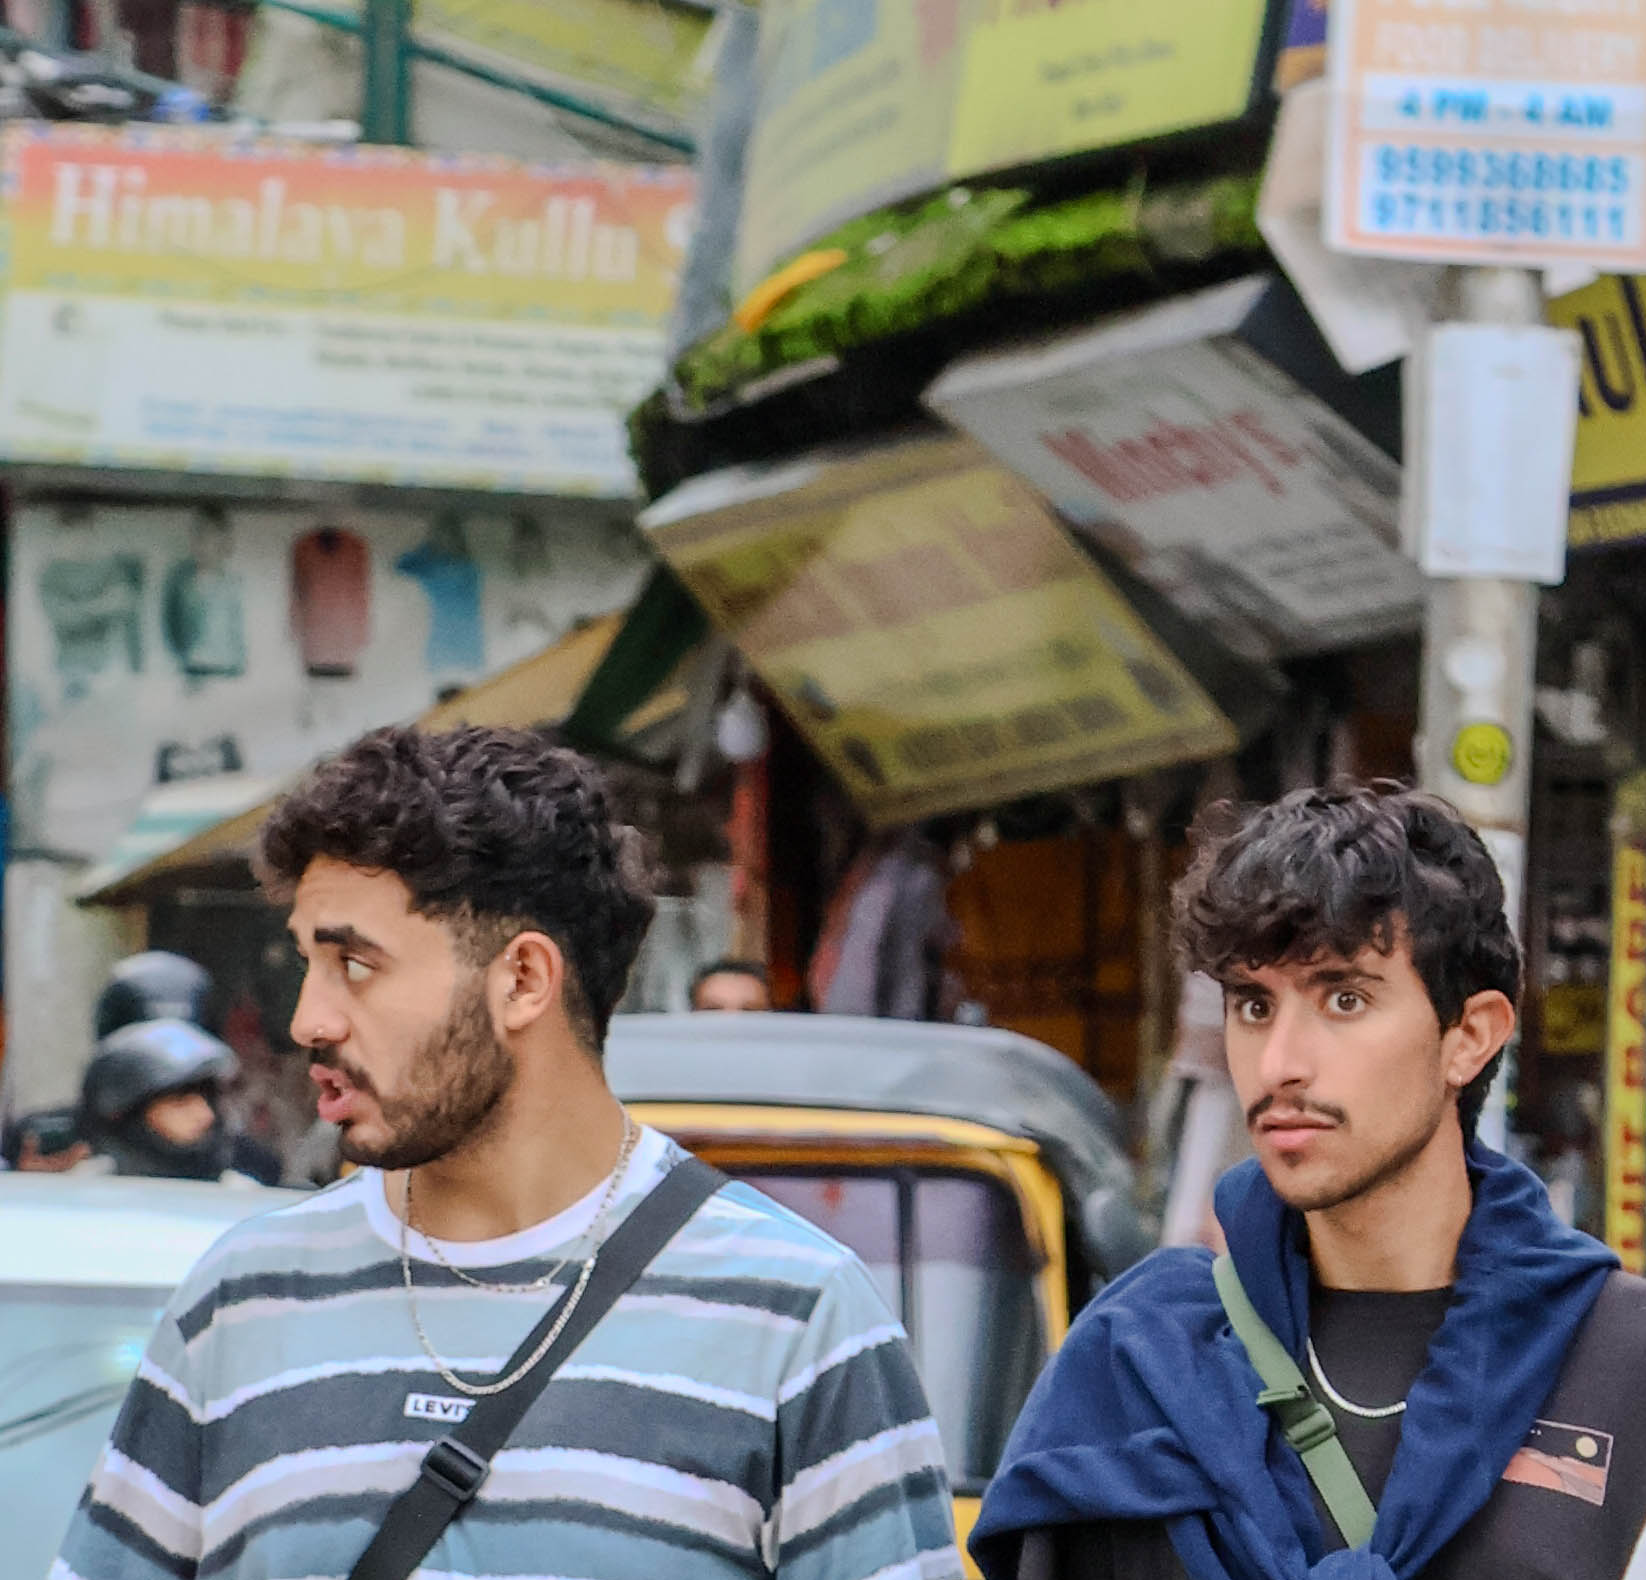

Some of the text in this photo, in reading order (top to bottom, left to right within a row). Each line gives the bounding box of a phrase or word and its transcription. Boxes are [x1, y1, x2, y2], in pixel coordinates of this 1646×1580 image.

[1398, 92, 1421, 118] 4
[1431, 88, 1490, 123] PM
[1523, 93, 1546, 123] 4
[1557, 94, 1615, 127] AM
[50, 160, 406, 292] Himalaya
[434, 188, 638, 284] Kullu
